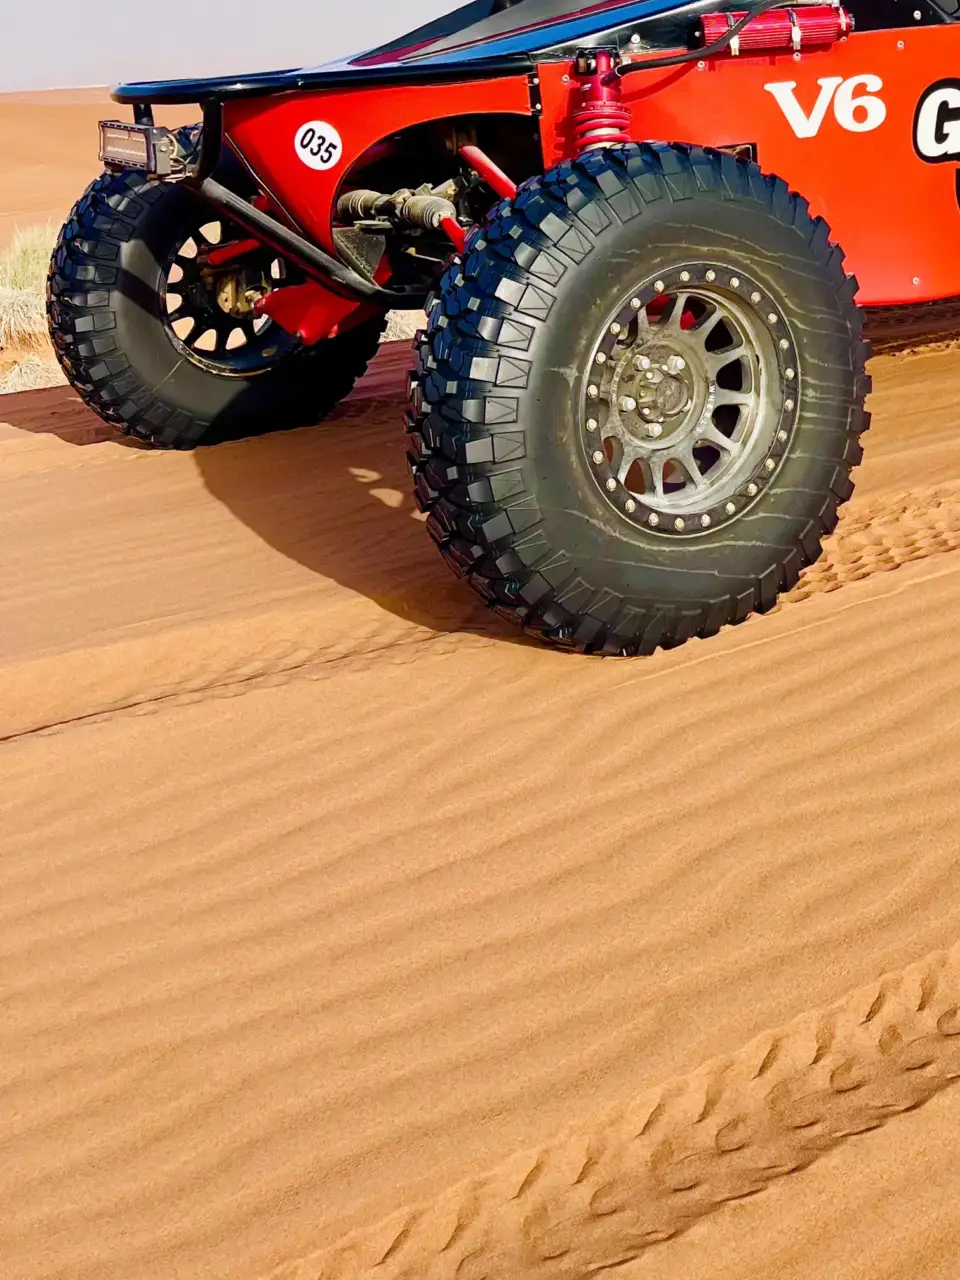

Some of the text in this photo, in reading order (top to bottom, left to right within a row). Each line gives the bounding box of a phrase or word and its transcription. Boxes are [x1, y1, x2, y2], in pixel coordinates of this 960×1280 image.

[764, 74, 887, 138] V6
[300, 127, 338, 164] 035
[696, 384, 716, 433] WHEELS
